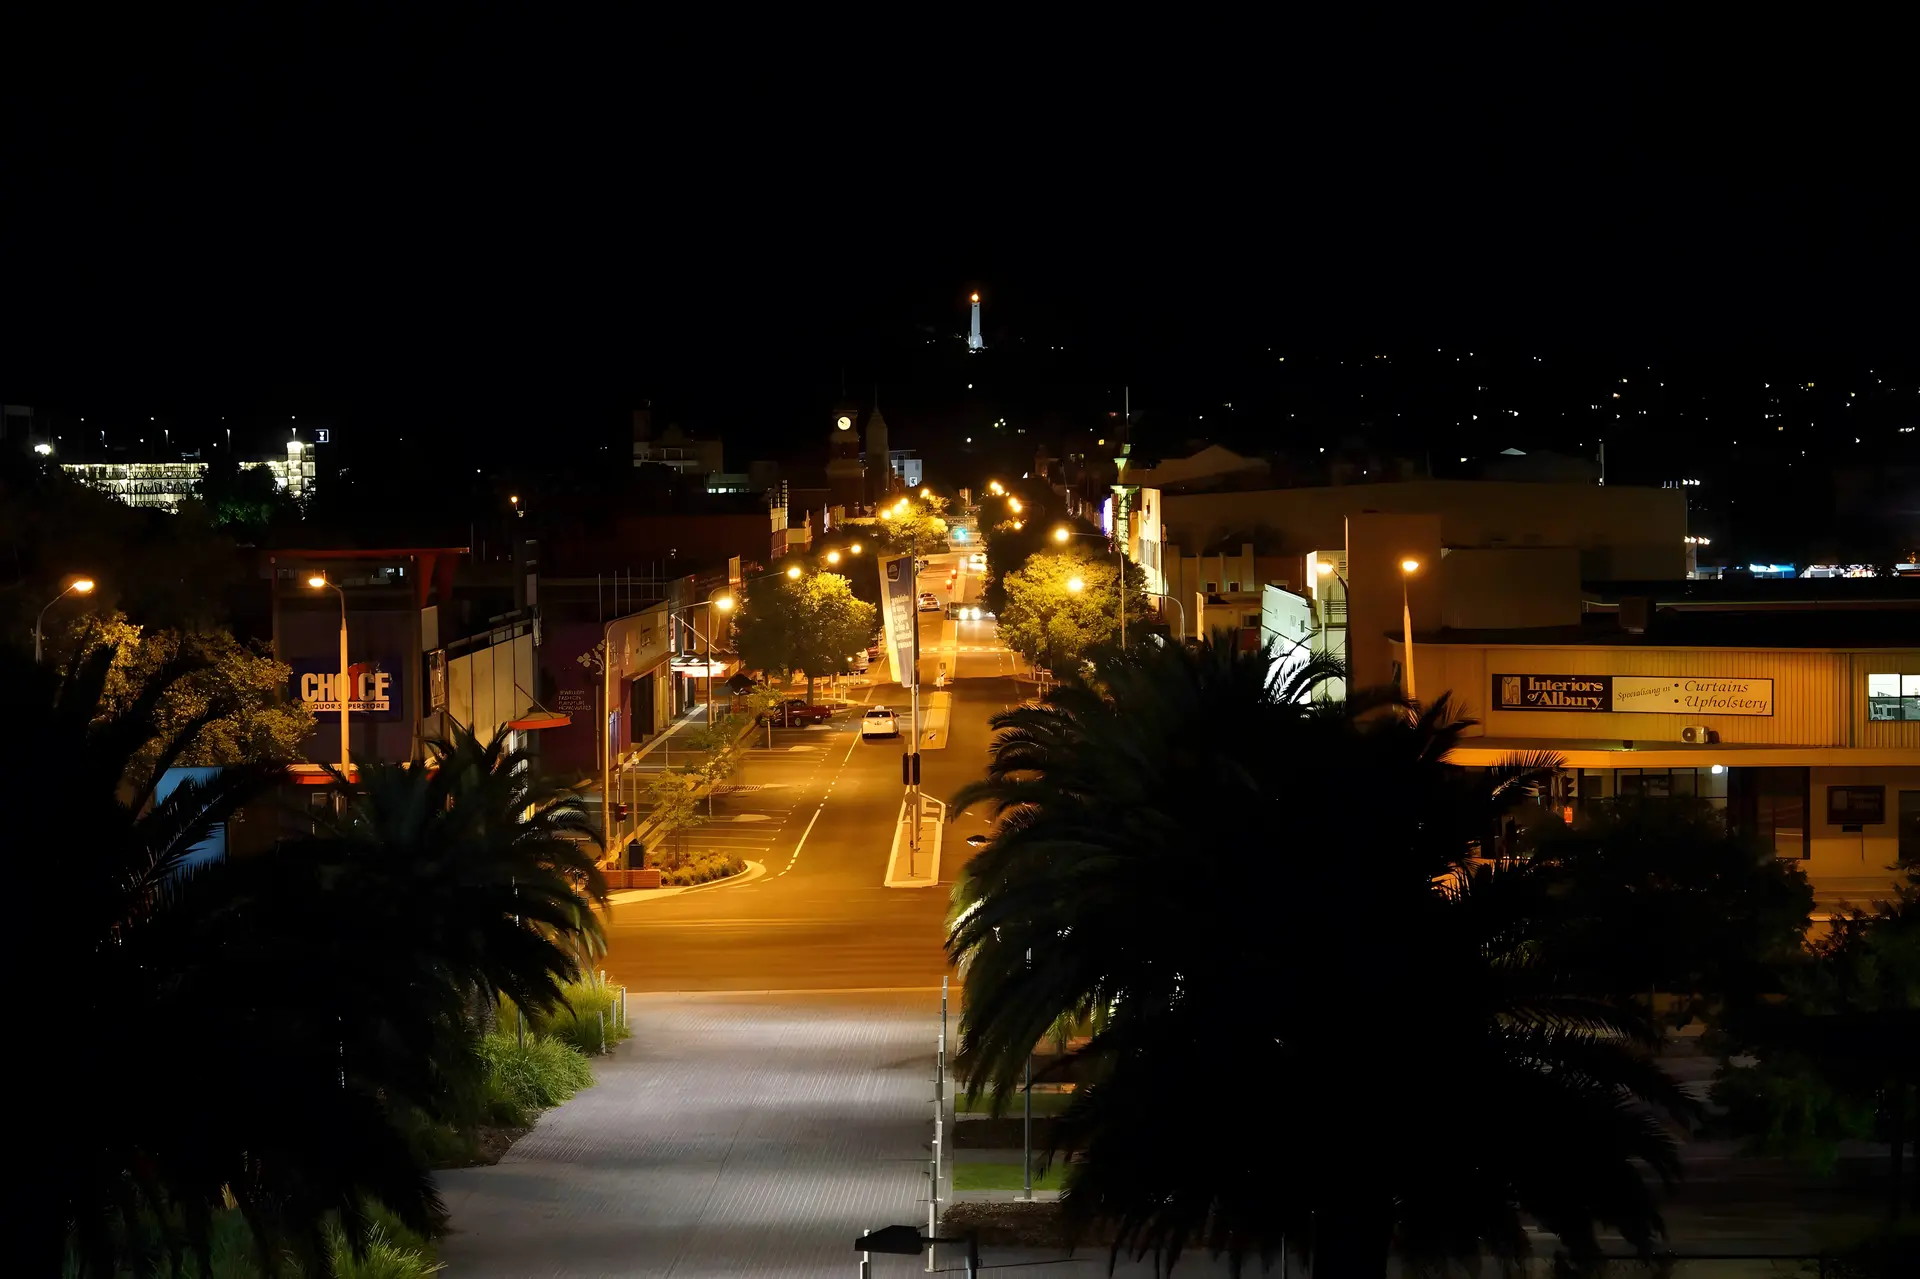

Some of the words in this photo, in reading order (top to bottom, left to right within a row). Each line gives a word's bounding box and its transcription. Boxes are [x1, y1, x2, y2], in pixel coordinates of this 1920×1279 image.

[1528, 676, 1604, 692] Interiors
[1684, 680, 1749, 693] Curtains
[337, 702, 385, 710] SPERSTORE
[1527, 691, 1541, 702] of
[1537, 691, 1604, 710] Albury
[1684, 695, 1768, 713] Upholstery
